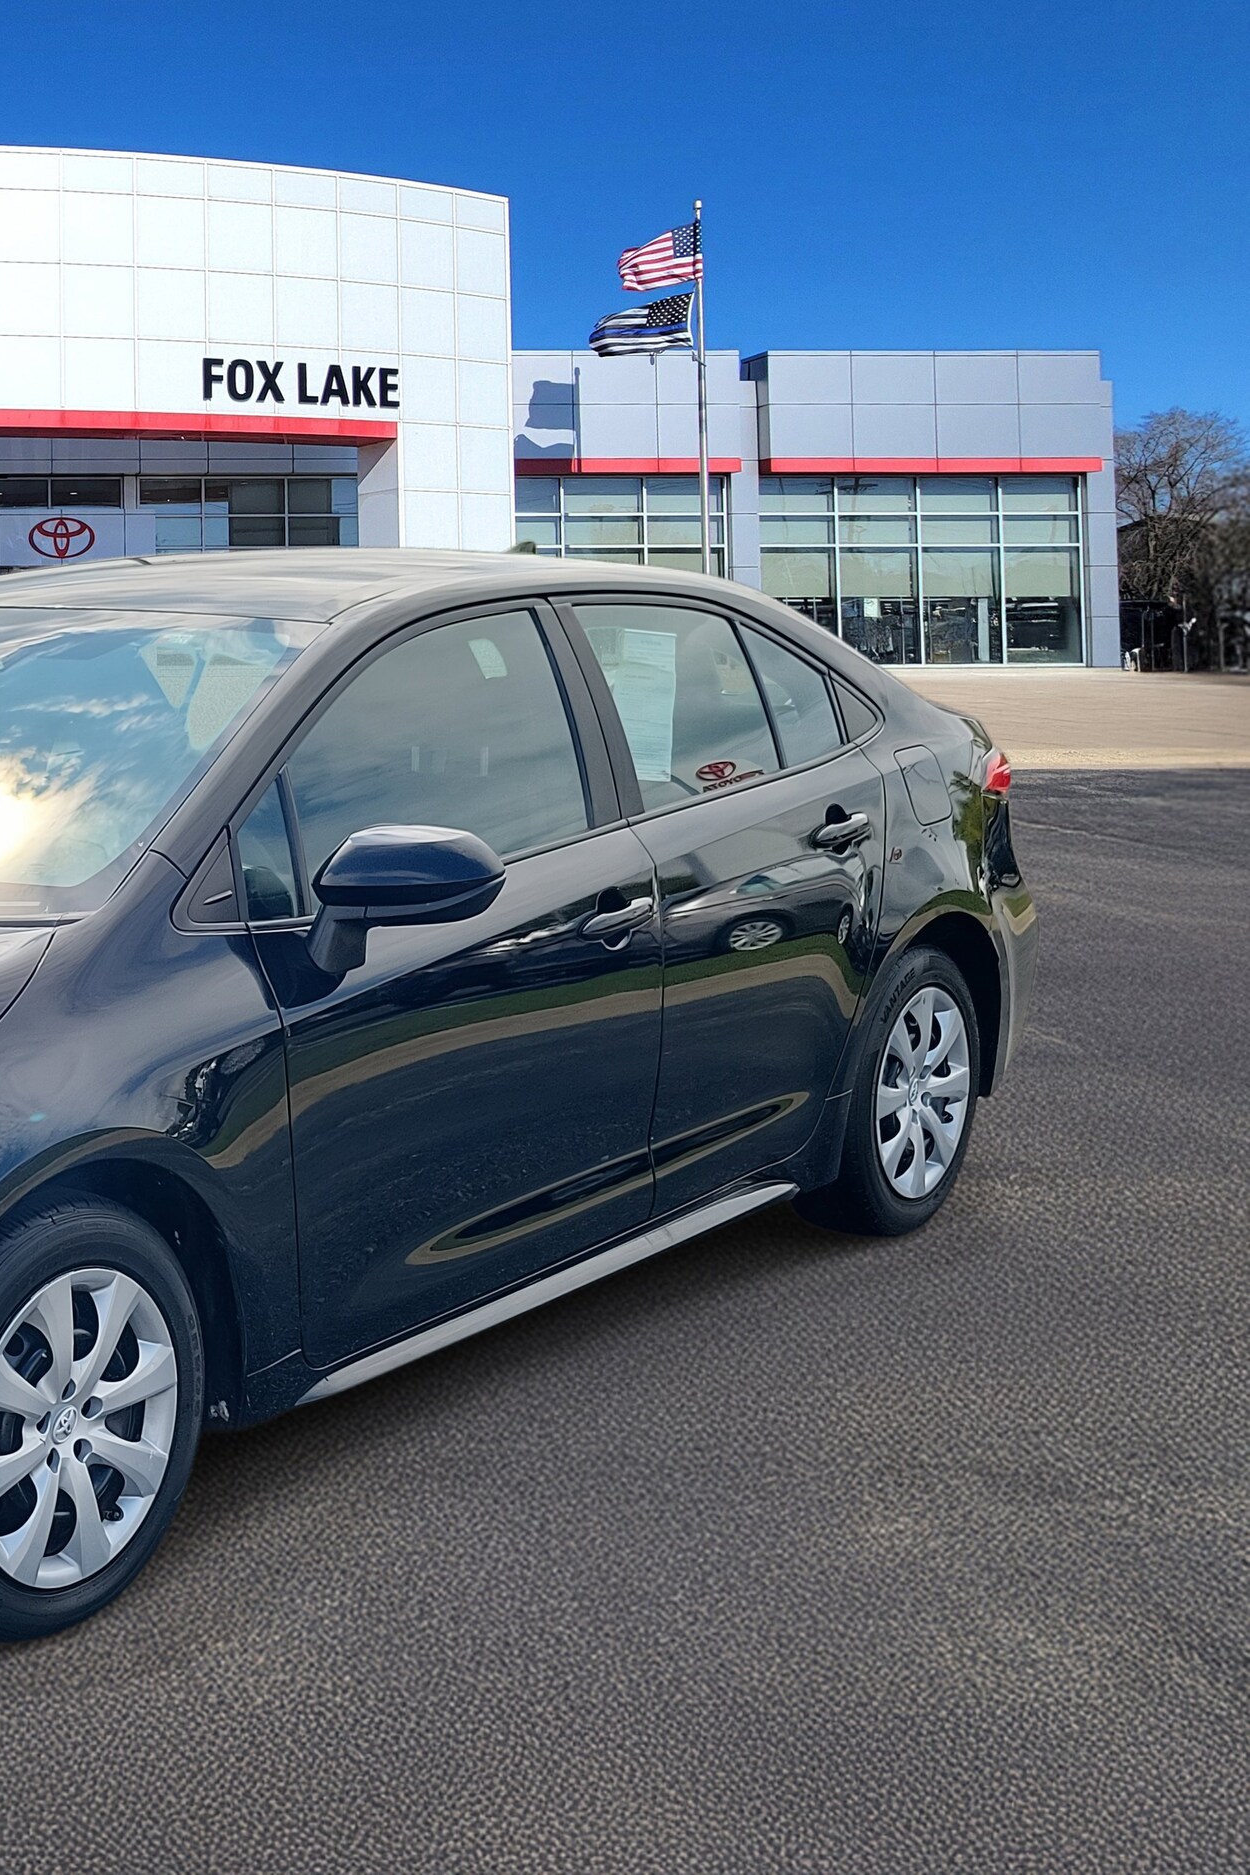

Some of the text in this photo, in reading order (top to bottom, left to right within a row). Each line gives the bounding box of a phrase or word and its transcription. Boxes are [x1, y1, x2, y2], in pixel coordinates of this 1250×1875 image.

[203, 358, 400, 408] FOX LAKE
[880, 967, 916, 1024] VANTAGE
